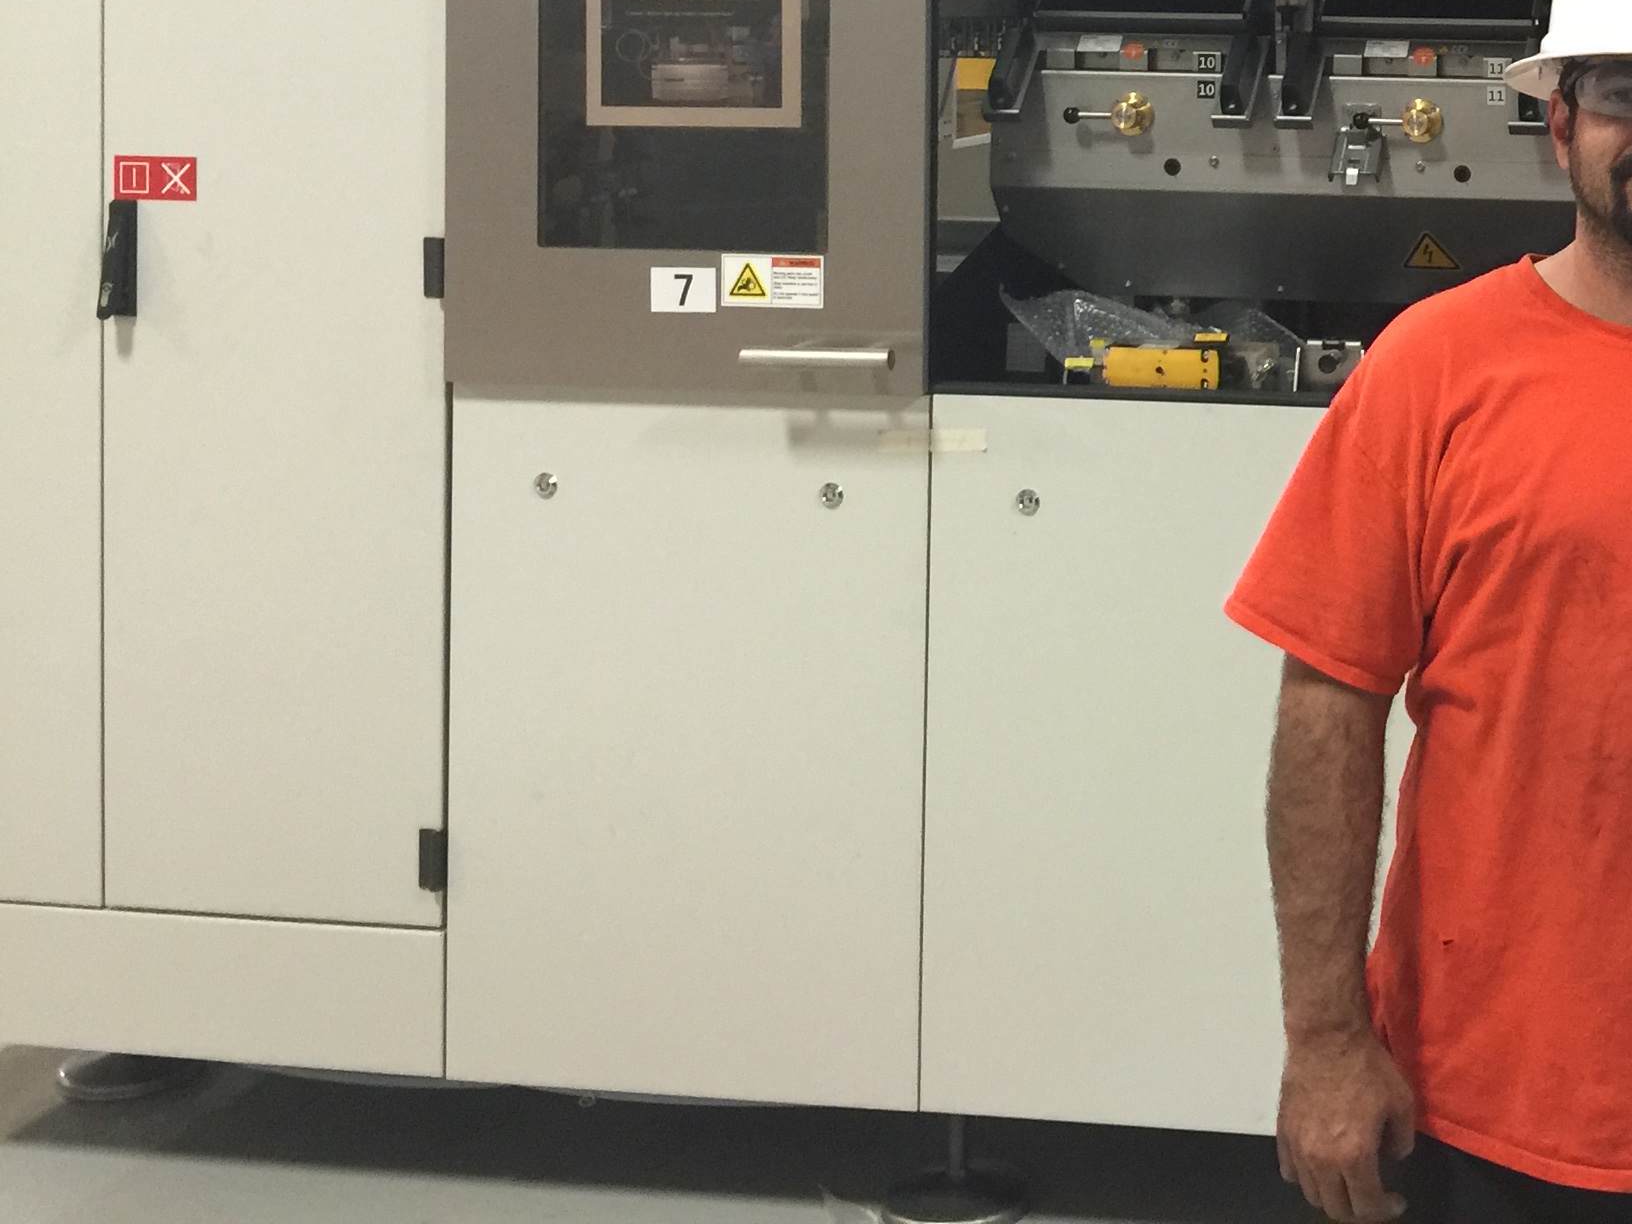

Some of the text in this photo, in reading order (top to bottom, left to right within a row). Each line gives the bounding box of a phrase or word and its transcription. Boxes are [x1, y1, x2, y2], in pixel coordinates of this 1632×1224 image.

[1199, 56, 1216, 69] 10
[1489, 63, 1504, 75] 11
[1198, 83, 1215, 96] 10
[1488, 90, 1504, 102] 11
[674, 274, 693, 306] 7
